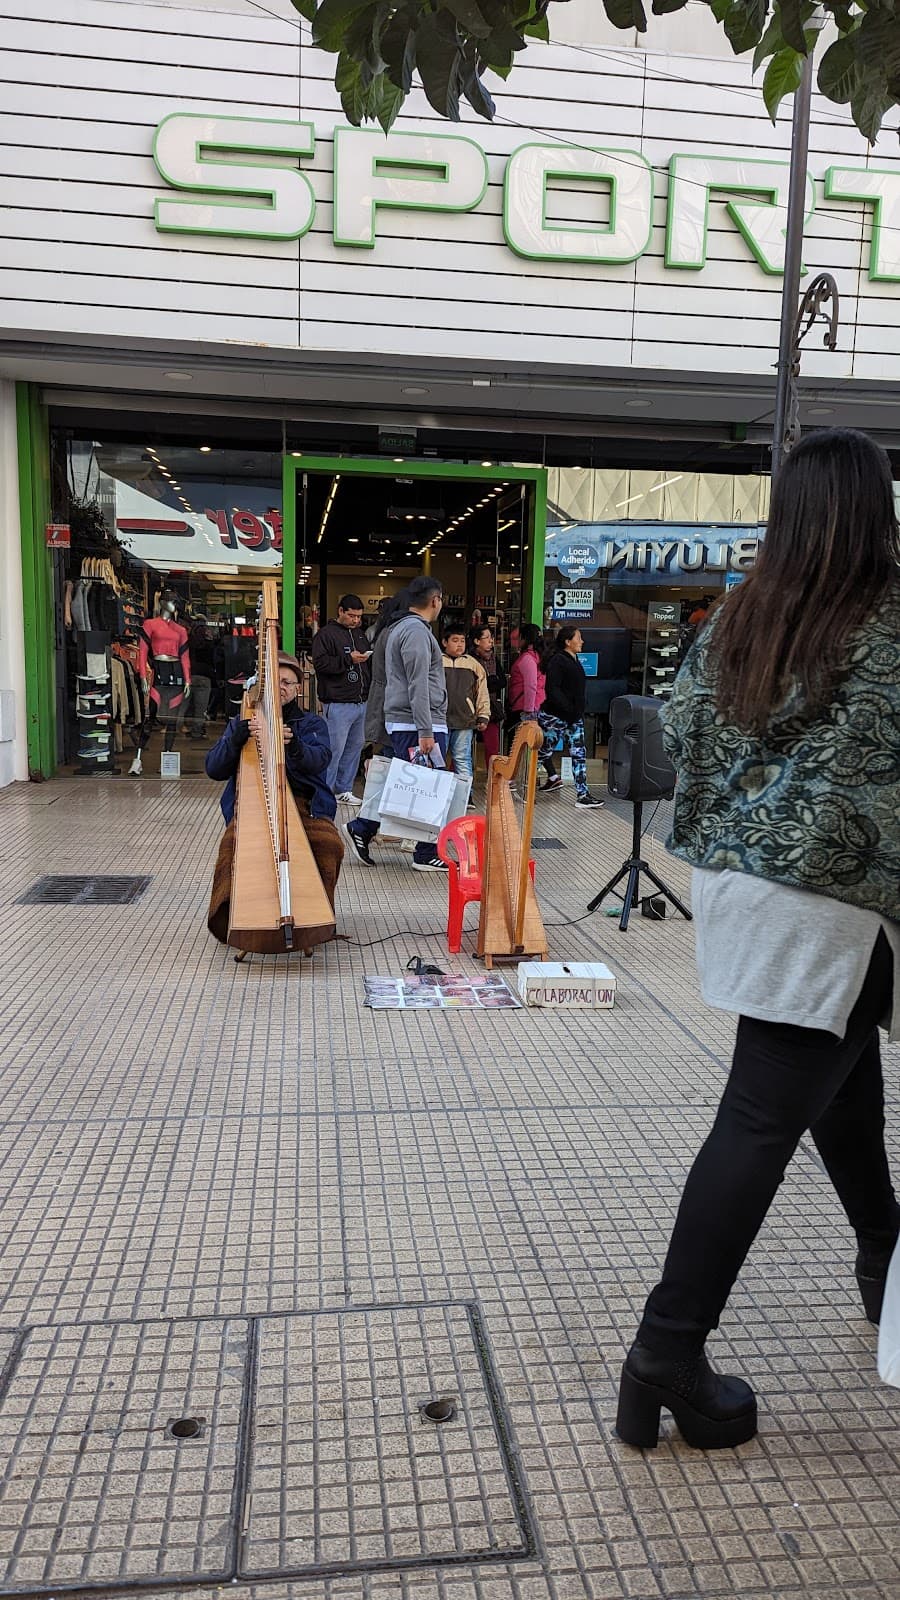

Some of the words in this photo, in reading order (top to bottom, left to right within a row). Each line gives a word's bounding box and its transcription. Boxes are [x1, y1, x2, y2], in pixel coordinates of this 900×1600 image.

[568, 547, 590, 556] Local
[561, 555, 596, 565] Adherido
[555, 590, 567, 607] 3
[567, 590, 592, 599] CUOTAS
[652, 612, 675, 621] Topper
[393, 783, 438, 800] BATISTELLA
